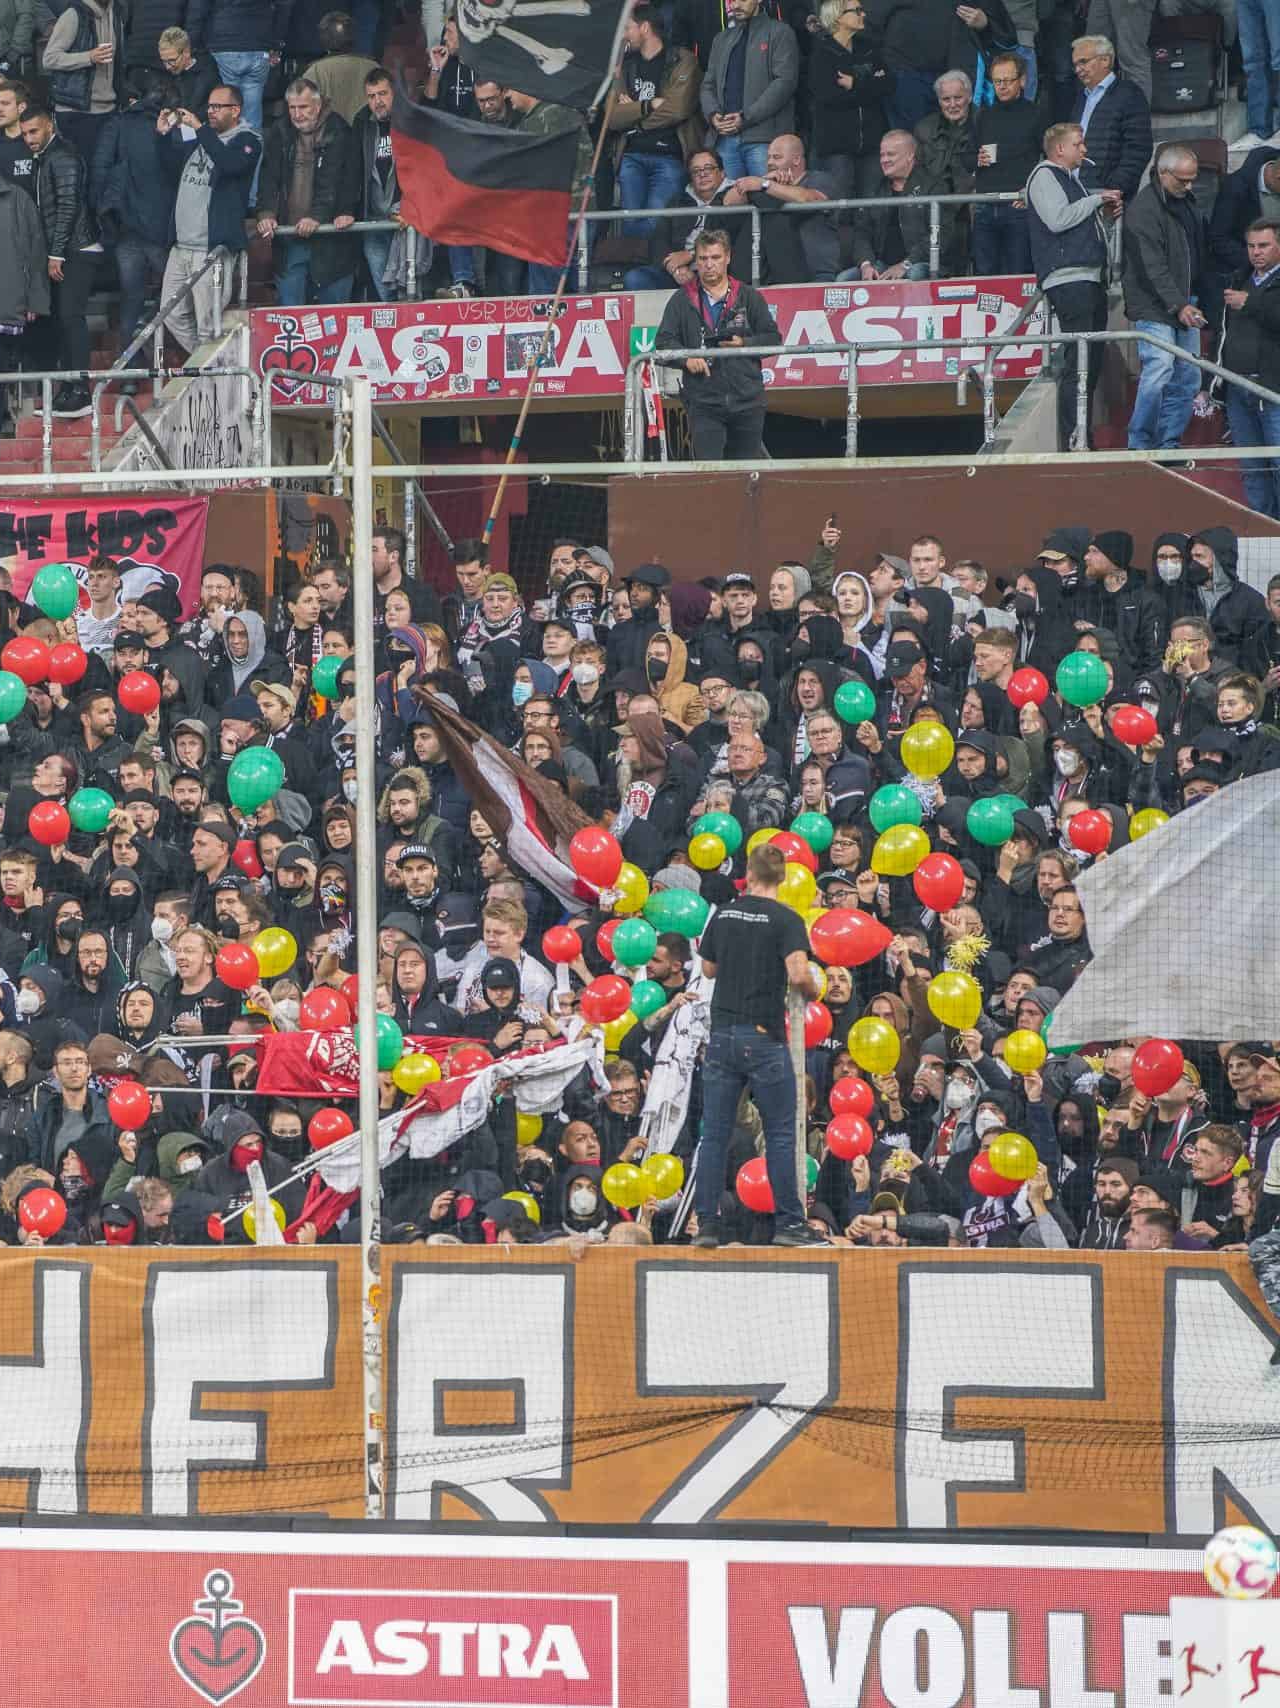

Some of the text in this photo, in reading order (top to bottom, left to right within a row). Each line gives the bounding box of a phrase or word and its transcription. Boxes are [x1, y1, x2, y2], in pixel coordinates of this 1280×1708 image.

[331, 319, 625, 387] ASTRA
[65, 508, 179, 560] KIDS
[316, 1620, 590, 1682] ASTRA
